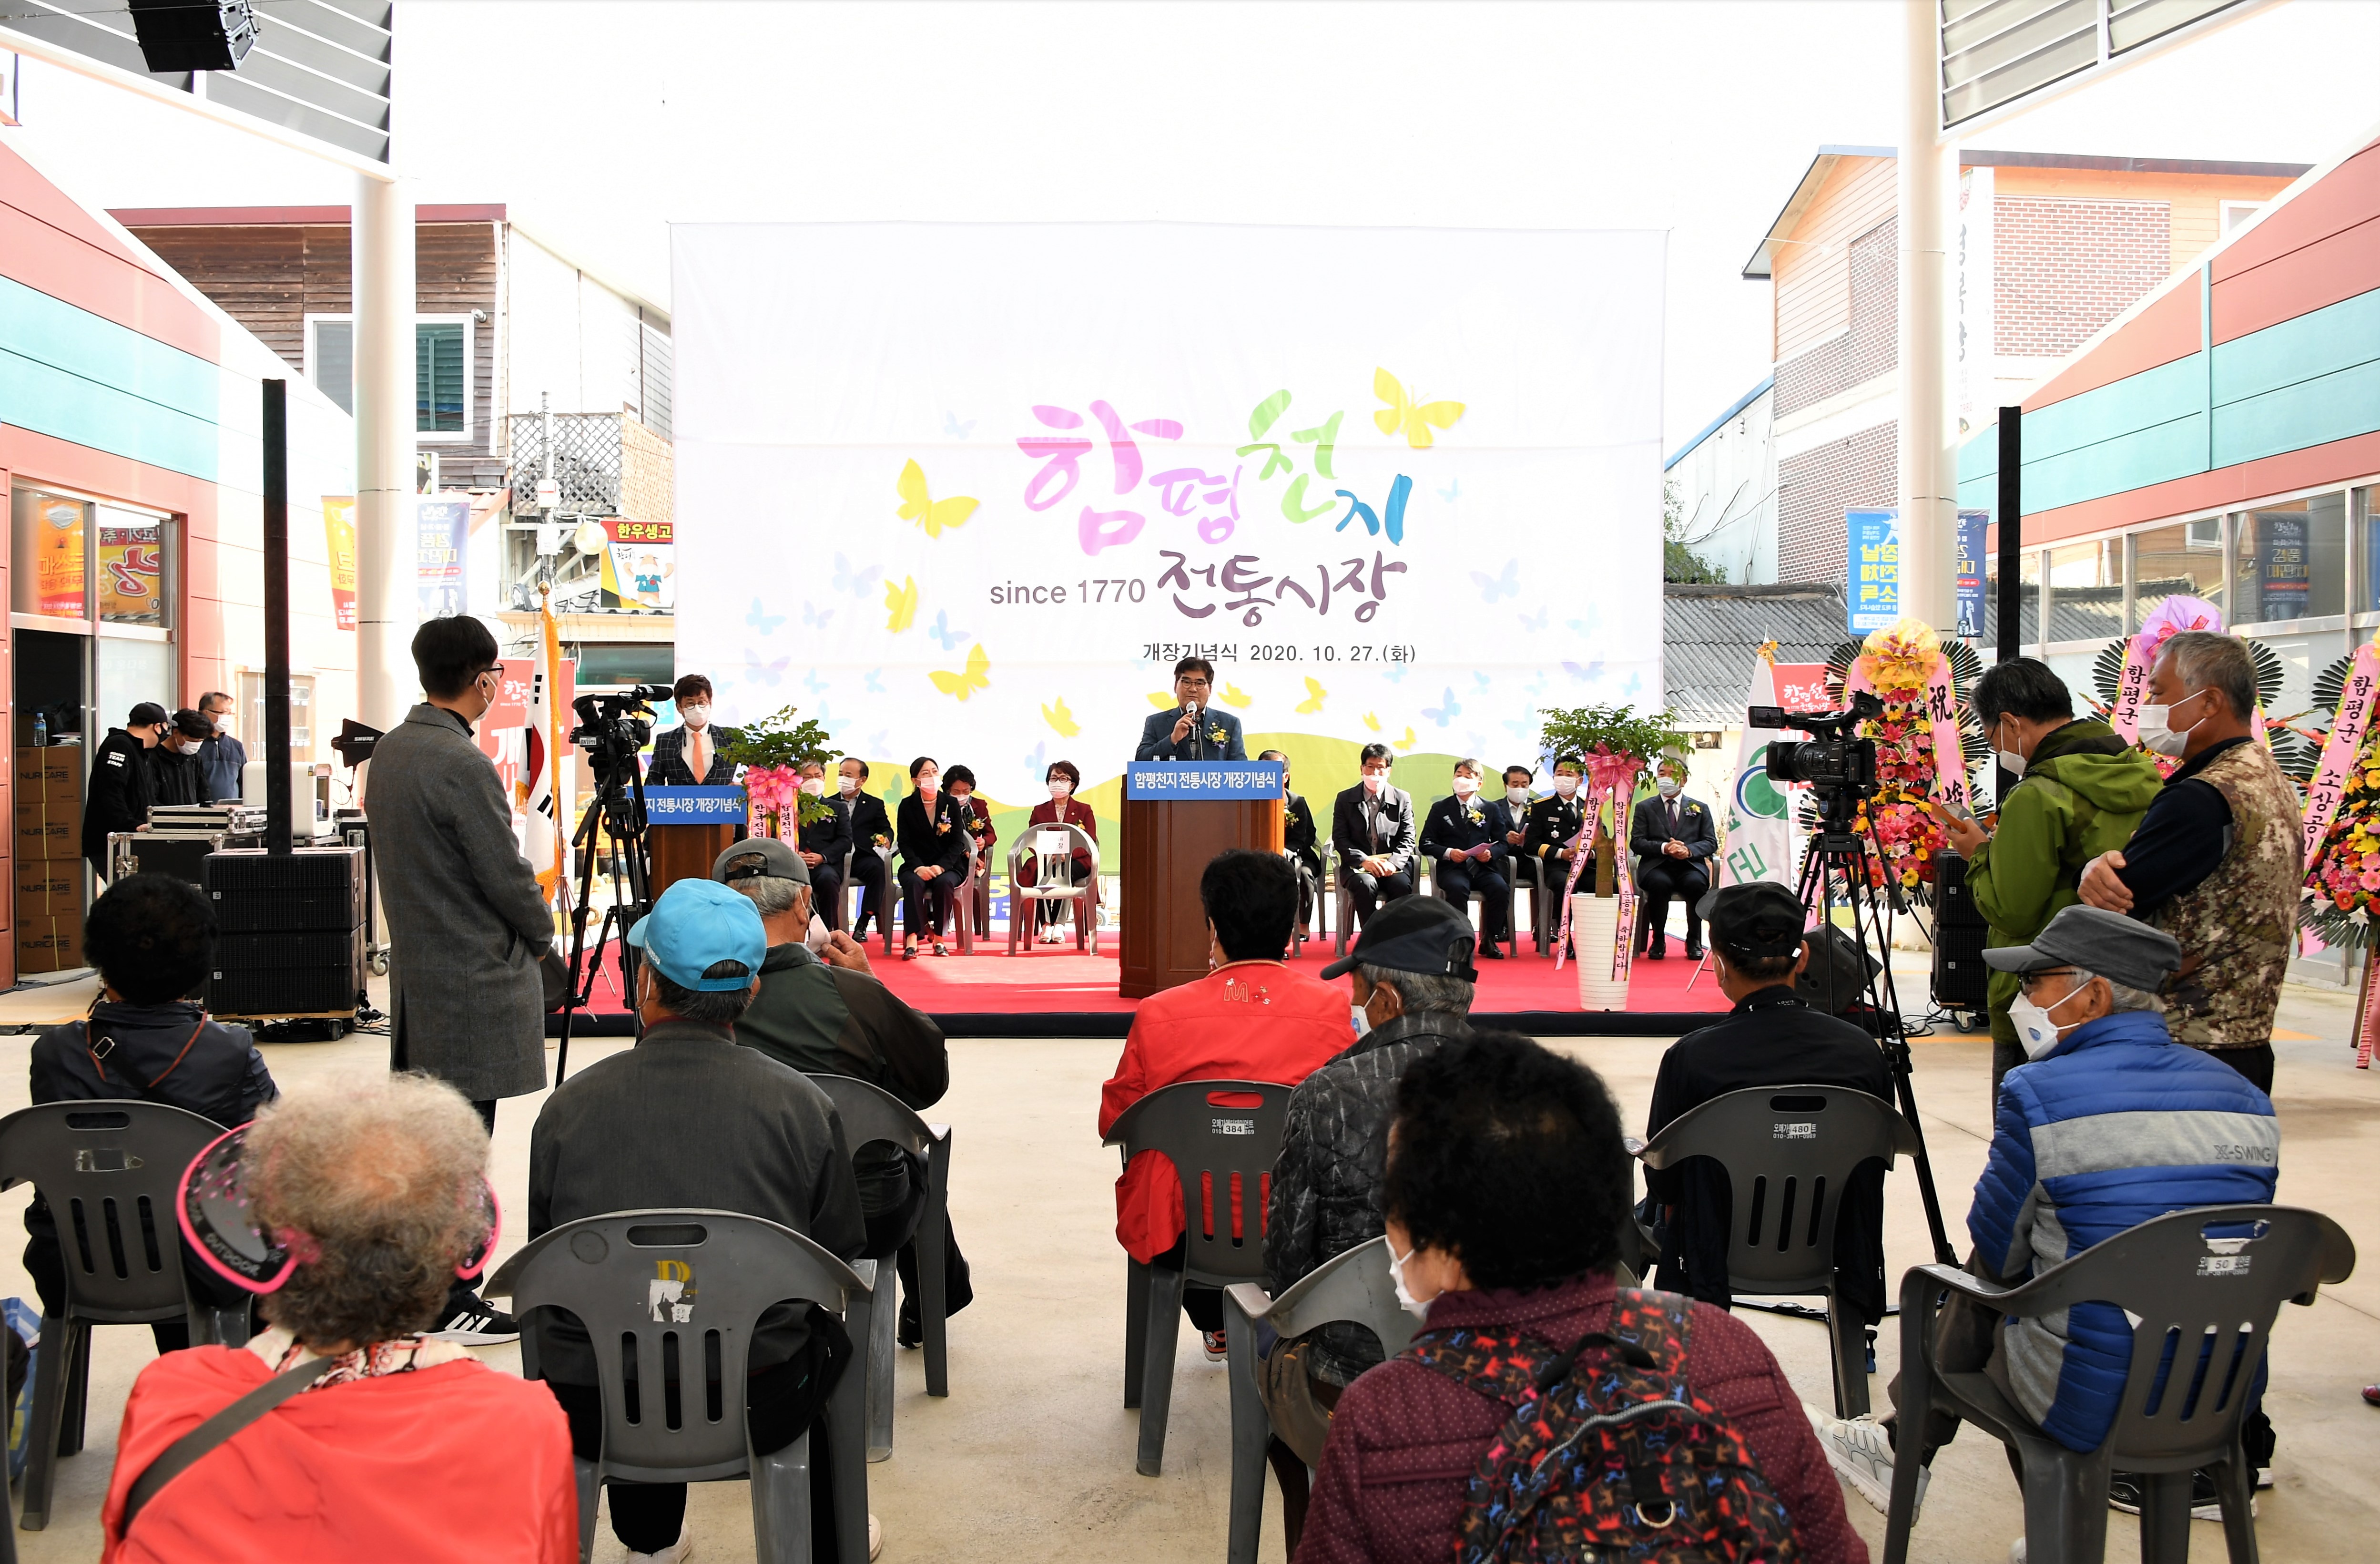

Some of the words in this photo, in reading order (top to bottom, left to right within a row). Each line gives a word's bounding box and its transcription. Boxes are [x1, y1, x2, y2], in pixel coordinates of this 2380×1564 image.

[1016, 388, 1414, 557] 함평천지
[990, 580, 1067, 604] since
[1078, 579, 1146, 603] 1770
[1157, 549, 1408, 627] 전통시장
[1143, 643, 1237, 662] 개장기념식
[1250, 644, 1303, 661] 2020.
[1313, 645, 1341, 662] 10.
[1351, 645, 1415, 664] 27.(화)
[1934, 685, 1953, 723] 祝
[2117, 665, 2146, 726] 함평군
[2337, 675, 2373, 744] 함평군
[1134, 771, 1177, 789] 함평천지
[1179, 771, 1222, 789] 전통시장
[1223, 771, 1276, 789] 개장기념식
[657, 797, 694, 813] 전통시장
[1616, 846, 1627, 881] 전통시장
[1621, 890, 1633, 917] 준공을
[1616, 926, 1629, 970] 축하합니다
[1225, 1124, 1242, 1133] 384
[1792, 1125, 1809, 1133] 480
[2213, 1144, 2271, 1162] X-SWING
[2215, 1259, 2229, 1269] 50
